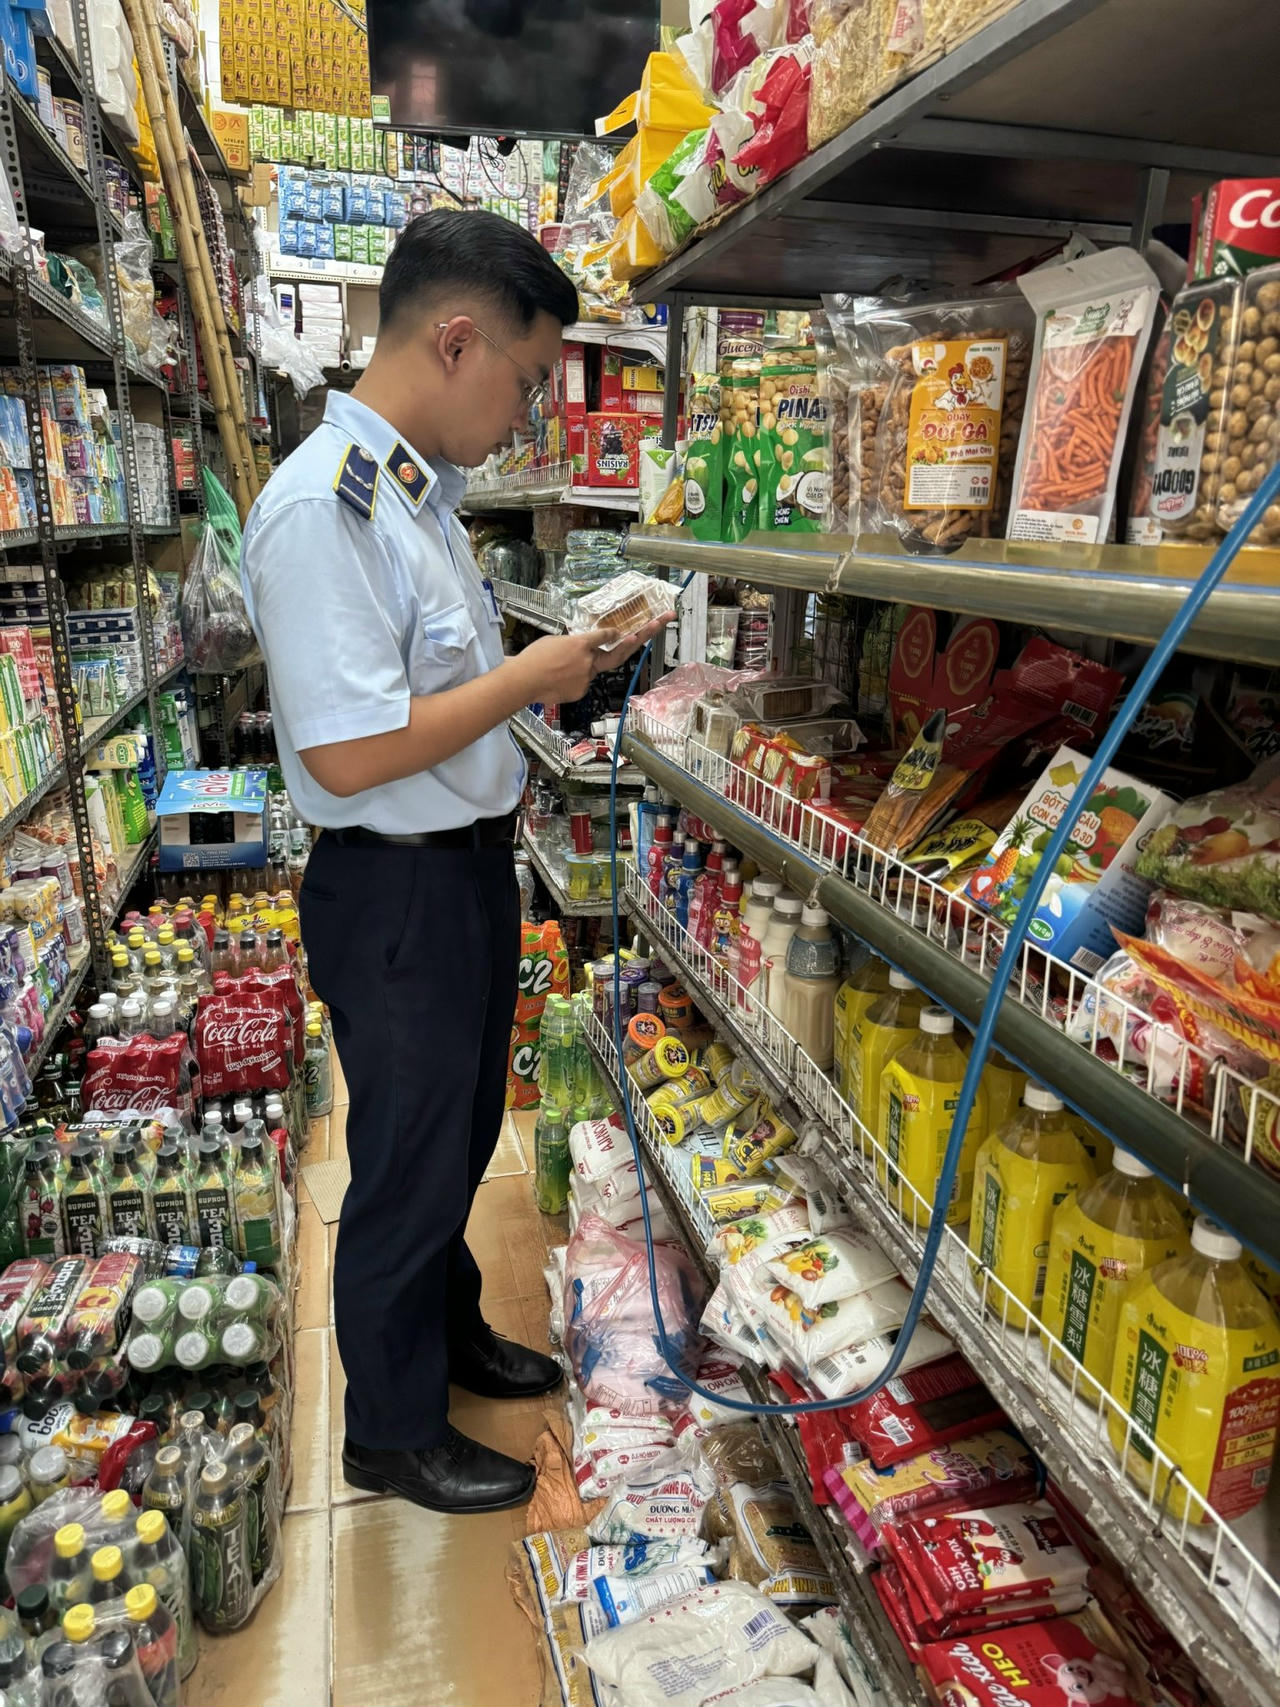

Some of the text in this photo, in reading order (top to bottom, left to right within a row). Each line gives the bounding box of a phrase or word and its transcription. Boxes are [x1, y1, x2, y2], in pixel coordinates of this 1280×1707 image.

[789, 384, 810, 394] Oishi
[596, 460, 630, 469] RAISINS
[1042, 792, 1061, 811] BỘT
[1031, 805, 1050, 822] CON
[1078, 811, 1097, 830] CÂU
[1081, 832, 1093, 846] 3D
[518, 954, 553, 994] C2
[203, 1016, 282, 1048] Coca-Cola
[70, 1215, 96, 1226] TEA
[115, 1210, 141, 1222] TEA
[158, 1212, 184, 1222] TEA
[200, 1207, 226, 1219] TEA
[1066, 1260, 1091, 1353] 冰糖雪梨
[650, 1505, 680, 1514] ĐƯỜNG
[645, 1515, 662, 1523] CHẤT
[664, 1516, 686, 1524] LƯỢNG
[946, 1566, 967, 1592] HEO
[957, 1558, 981, 1591] XÍCH
[981, 1642, 1032, 1689] HEO
